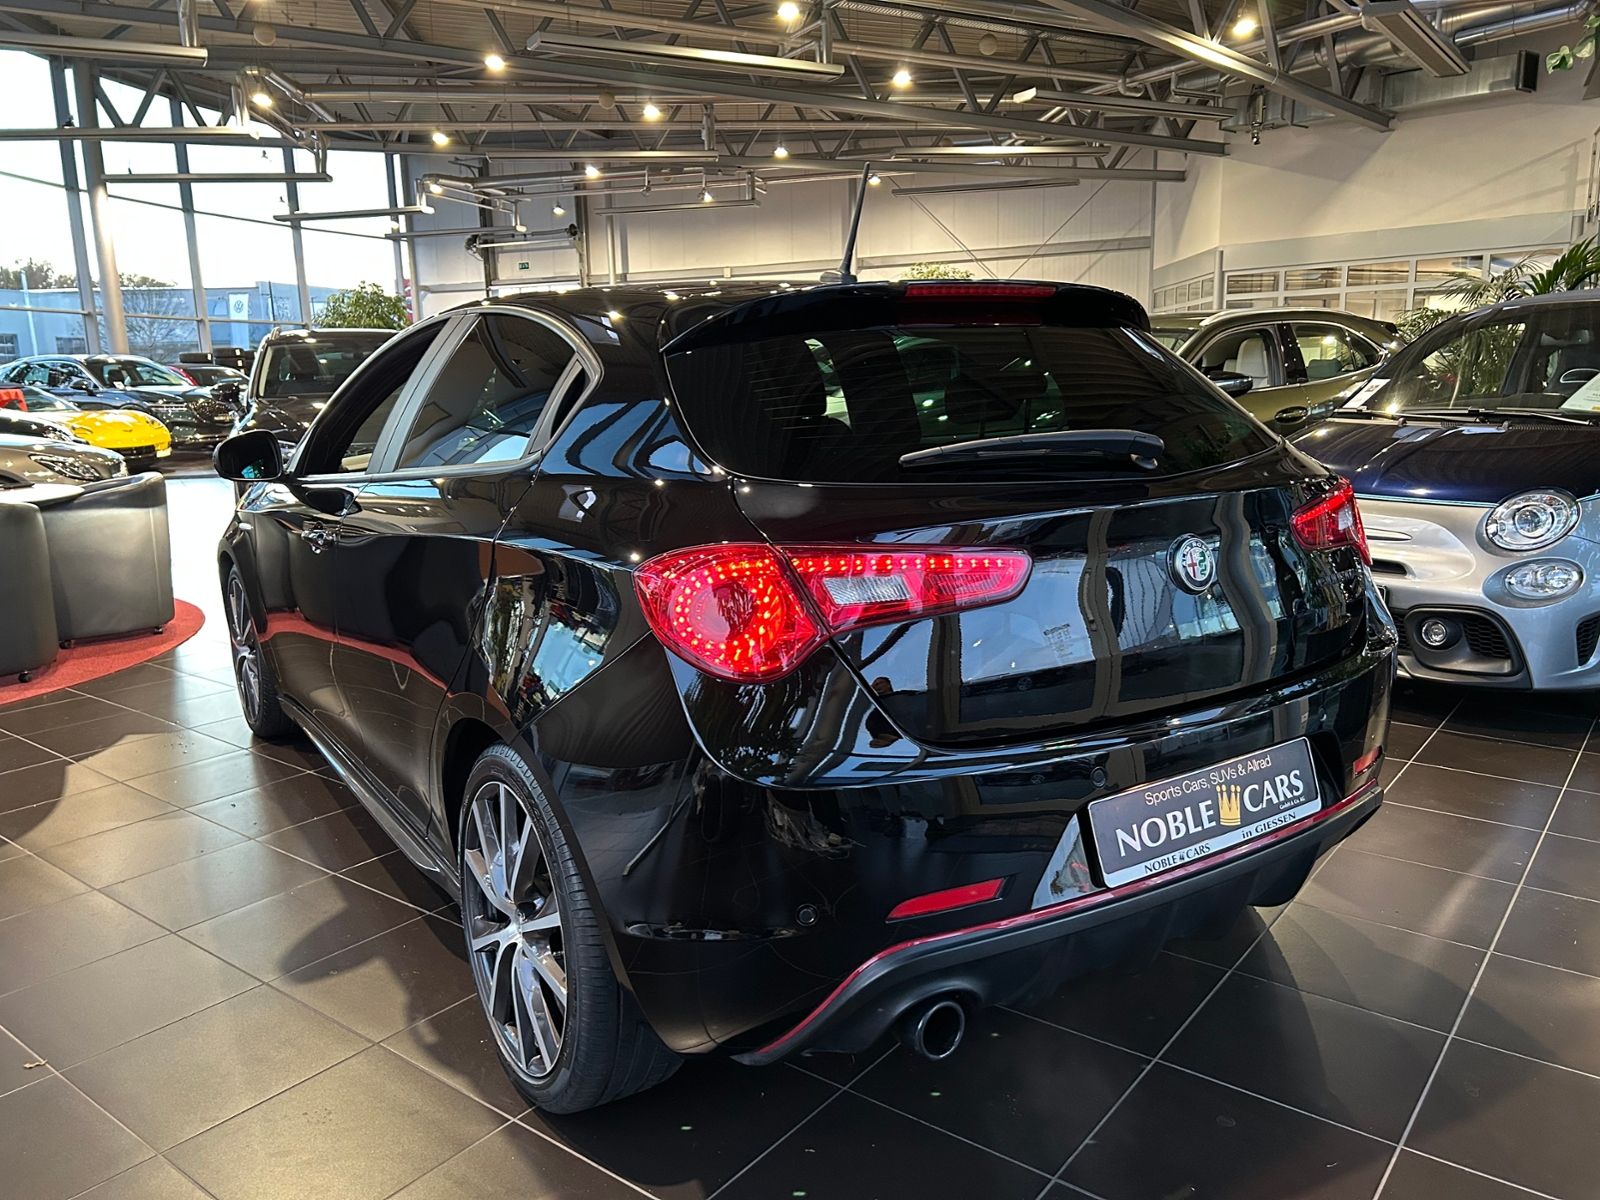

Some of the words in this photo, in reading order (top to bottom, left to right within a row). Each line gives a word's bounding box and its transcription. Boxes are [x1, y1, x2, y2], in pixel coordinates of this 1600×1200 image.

[1144, 785, 1182, 806] Sports
[1182, 777, 1211, 794] Cars,
[1209, 767, 1237, 785] SUVs
[1237, 763, 1246, 776] &
[1247, 754, 1272, 773] Allrad
[1115, 800, 1217, 857] NOBLE
[1243, 769, 1304, 812] CARS
[1144, 854, 1178, 875] NOBLE
[1186, 843, 1211, 860] CARS
[1241, 829, 1253, 840] in
[1254, 812, 1297, 834] GIESSEN
